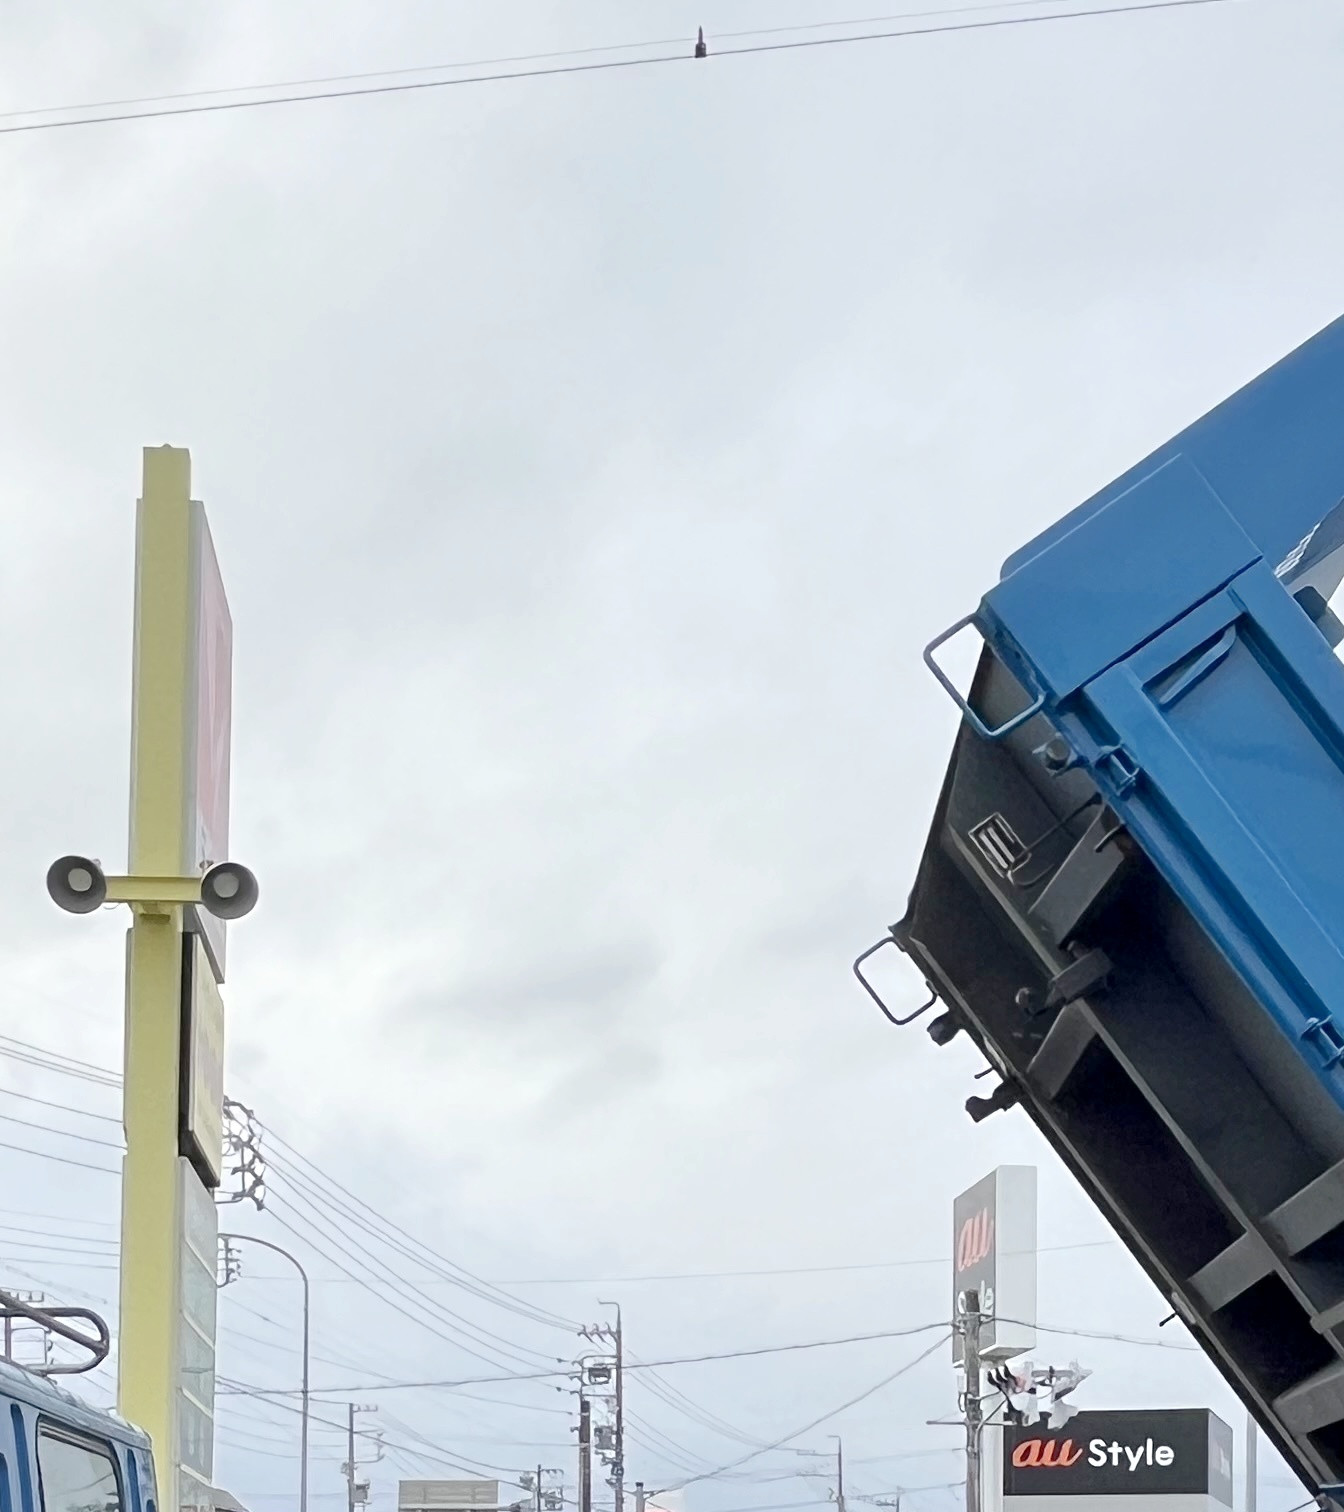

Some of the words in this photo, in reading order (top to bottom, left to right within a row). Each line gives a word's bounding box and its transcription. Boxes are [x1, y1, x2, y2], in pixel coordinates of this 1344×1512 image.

[958, 1207, 994, 1273] au
[1013, 1438, 1084, 1468] au
[1087, 1438, 1175, 1472] Style
